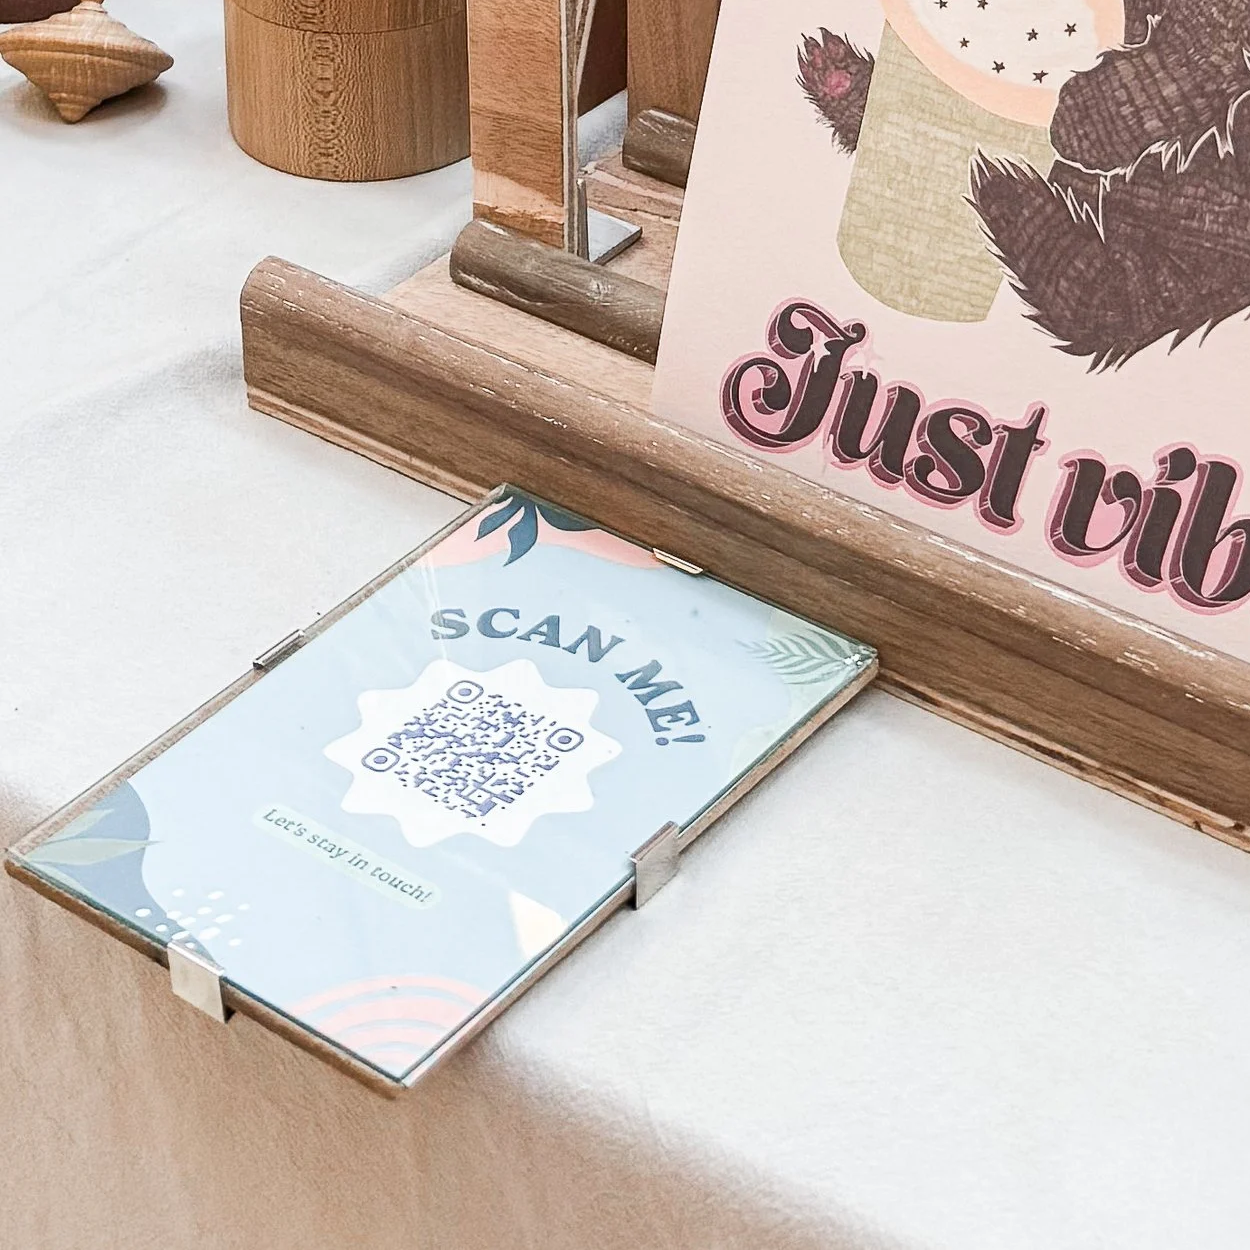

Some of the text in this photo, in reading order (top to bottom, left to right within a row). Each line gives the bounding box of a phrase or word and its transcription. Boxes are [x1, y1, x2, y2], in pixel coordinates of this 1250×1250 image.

[720, 298, 1050, 534] Just
[430, 607, 706, 747] SCAN ME!
[262, 808, 434, 903] Let's stay in touch!
